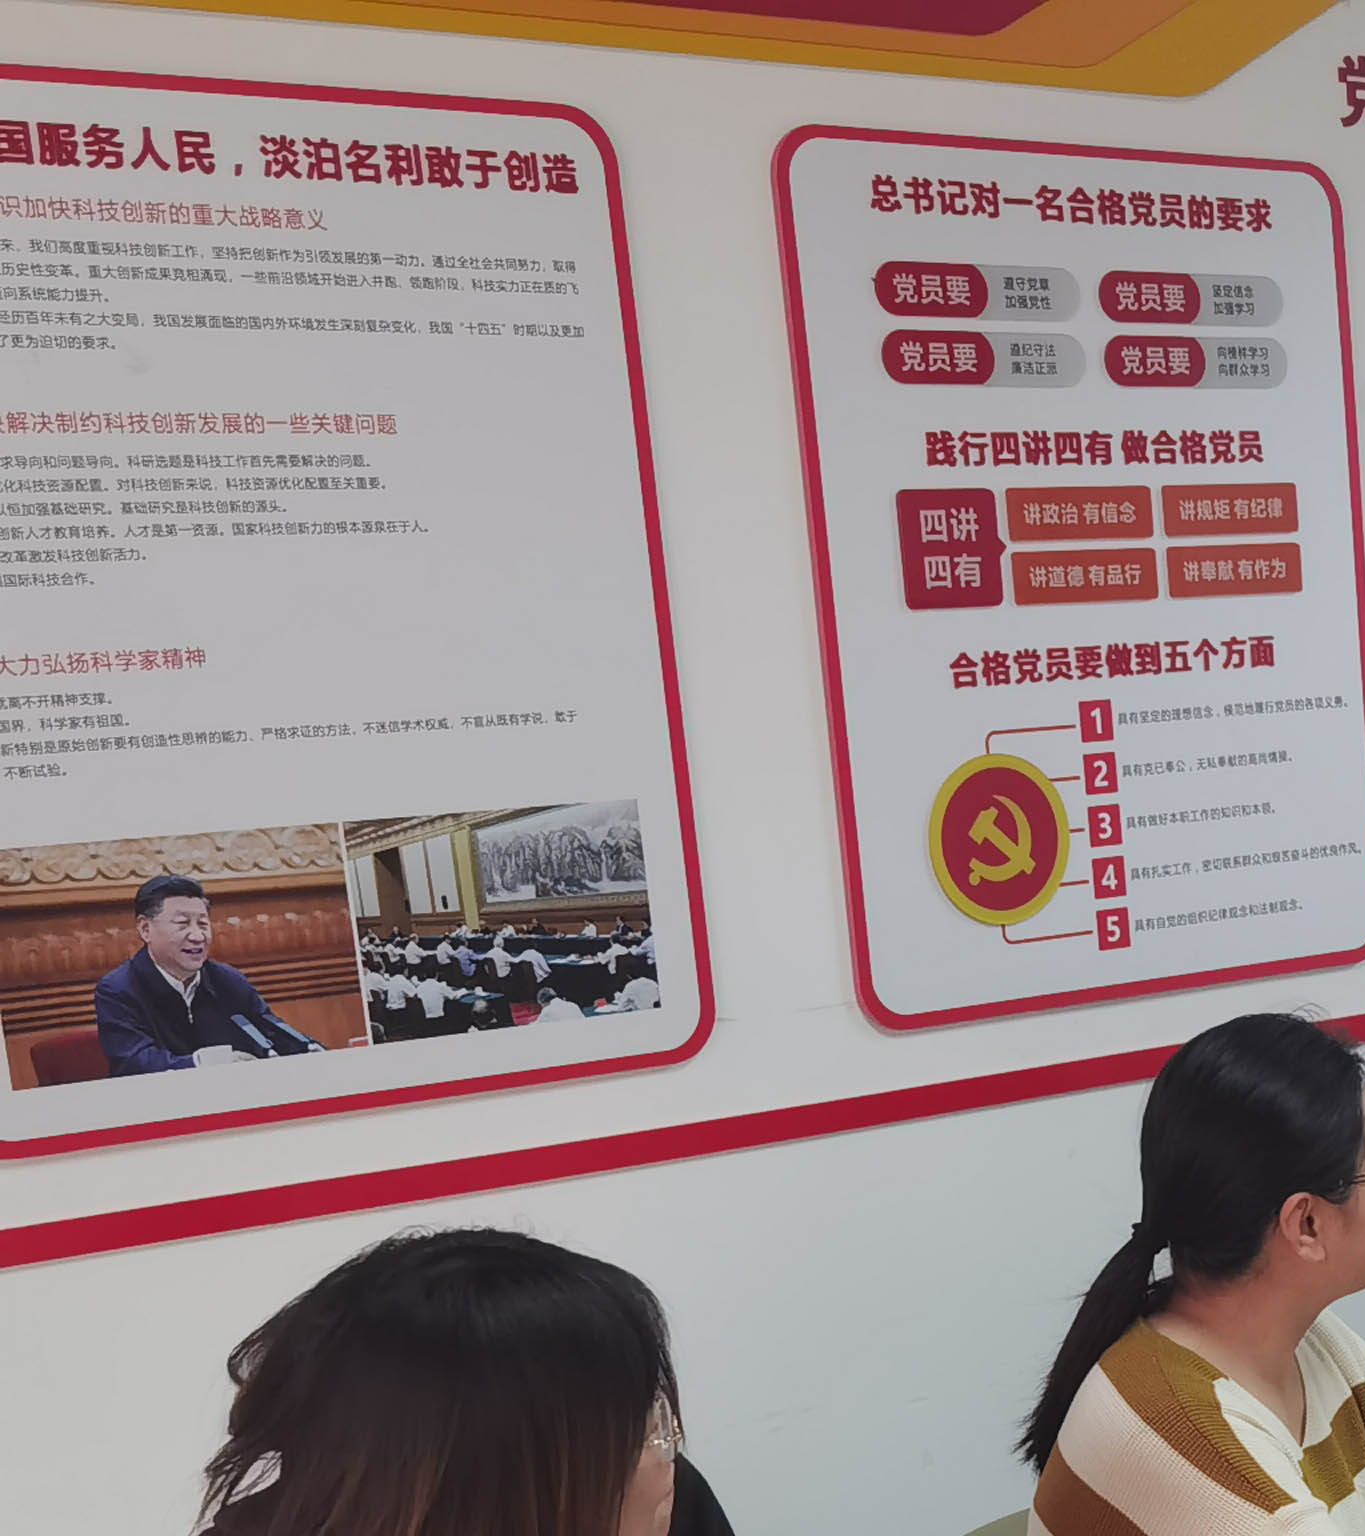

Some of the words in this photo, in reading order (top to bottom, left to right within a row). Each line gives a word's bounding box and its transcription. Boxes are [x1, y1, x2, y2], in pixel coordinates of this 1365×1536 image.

[871, 175, 1272, 232] 总书记对一名合格党员的要求
[0, 287, 109, 303] 向系统能力提升。
[892, 273, 972, 305] 党员要
[1115, 282, 1185, 313] 党员要
[900, 340, 978, 373] 党员要
[1121, 345, 1191, 376] 党员要
[0, 411, 398, 436] 解决制约科技创新发展的一些关键问题
[925, 430, 1113, 467] 践行四讲四有
[1121, 430, 1264, 465] 做合格党员
[1024, 503, 1079, 526] 讲政治
[1083, 502, 1137, 524] 有信念
[1179, 499, 1231, 522] 讲规矩
[1234, 497, 1283, 520] 有纪律
[920, 508, 980, 543] 四讲
[0, 572, 95, 588] 国际科技合作。
[924, 553, 982, 590] 四有
[1029, 565, 1084, 589] 讲道德
[1088, 563, 1142, 587] 有品行
[1183, 560, 1235, 582] 讲奉献
[1238, 558, 1287, 580] 有作为
[0, 646, 206, 677] 大力弘扬科学家精神
[949, 636, 1275, 689] 合格党员要做到五个方面
[1090, 707, 1104, 734] 1
[1094, 760, 1109, 788] 2
[1098, 812, 1113, 840] 3
[1101, 863, 1118, 891] 4
[1107, 915, 1121, 942] 5
